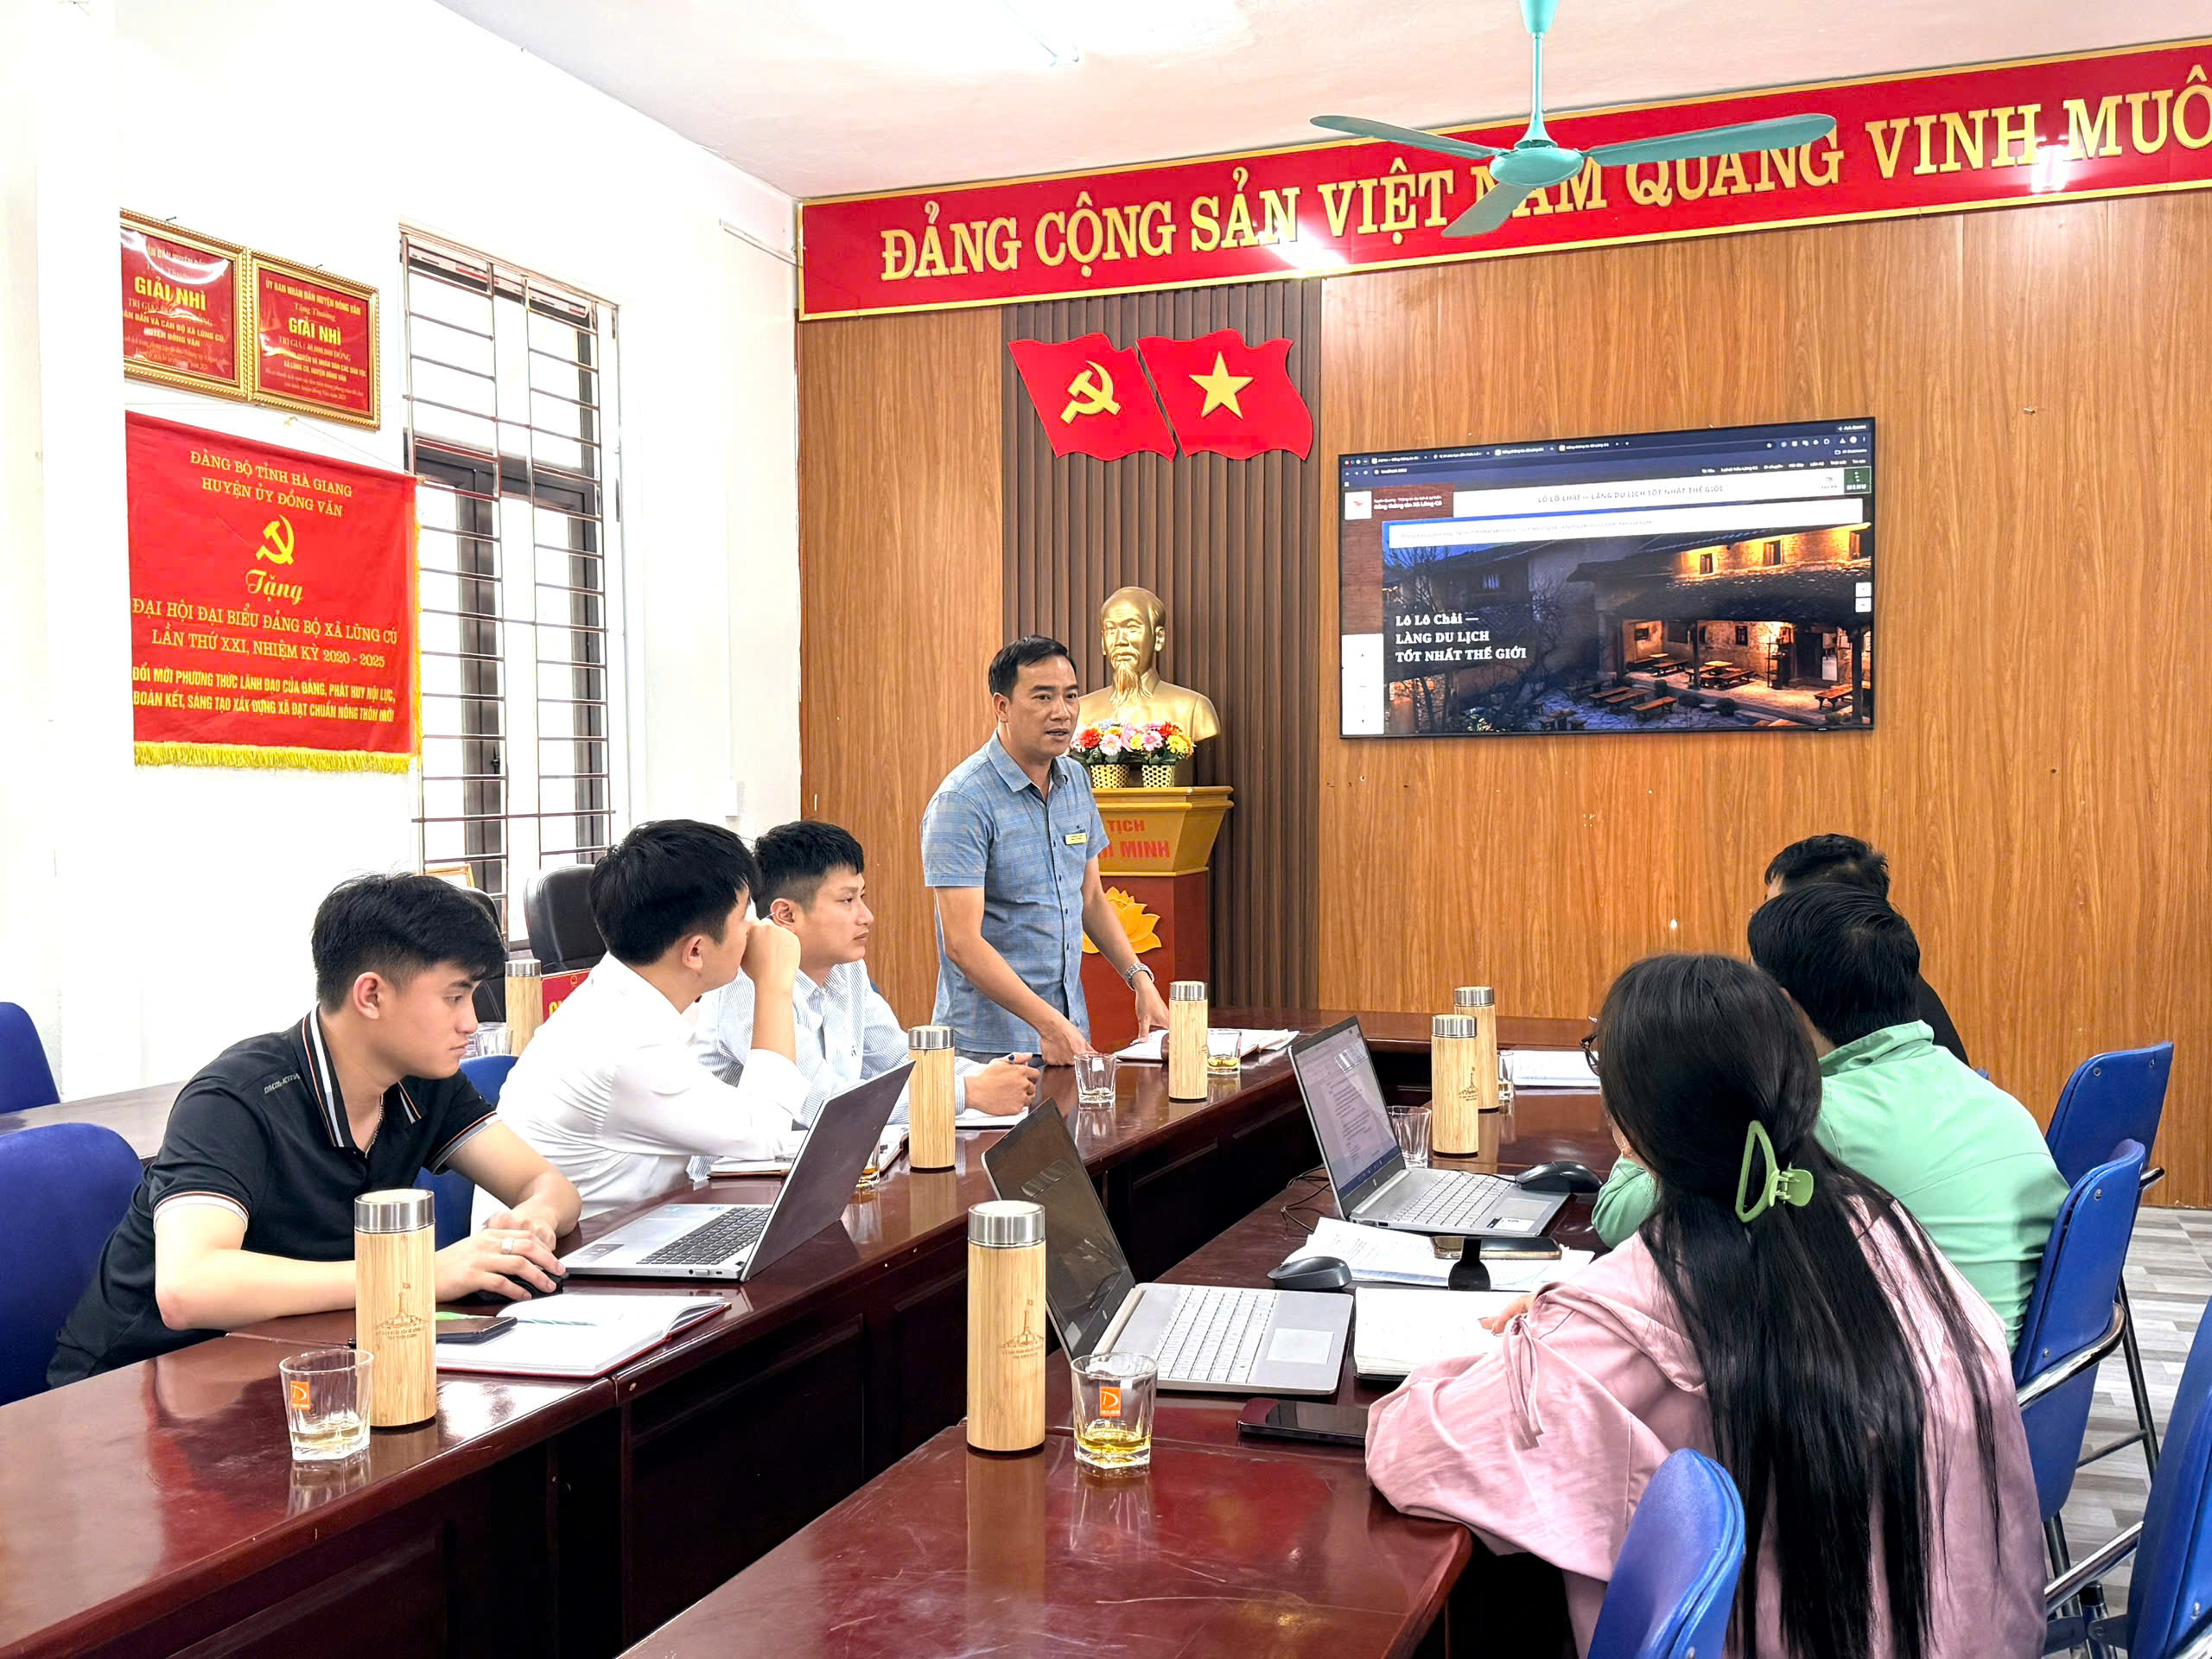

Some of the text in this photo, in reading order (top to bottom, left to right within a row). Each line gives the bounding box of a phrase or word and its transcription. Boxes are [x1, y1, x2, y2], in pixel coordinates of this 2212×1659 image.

[880, 200, 1022, 281] ĐẢNG
[1035, 191, 1177, 277] CỘNG
[1191, 167, 1300, 251] SẢN
[1317, 156, 1453, 245] VIỆT
[1625, 124, 1844, 207] QUANG
[1865, 104, 2041, 180] VINH
[135, 276, 207, 311] GIẢI NHÌ
[289, 316, 341, 346] GIẢI NHÌ
[190, 449, 353, 499] ĐẢNG BỘ TỈNH HÀ GIANG
[201, 477, 344, 518] HUYỆN ỦY ĐỒNG VĂN
[245, 569, 303, 606] Tặng
[132, 598, 162, 619] ĐẠI
[167, 599, 194, 622] HỘI
[197, 606, 224, 626] ĐẠI
[227, 602, 259, 628] BIỂU
[263, 609, 300, 632] ĐẢNG
[303, 616, 321, 639] BỘ
[324, 620, 342, 639] XÃ
[383, 627, 397, 645] CÚ
[1395, 614, 1412, 626] Lô
[1414, 613, 1431, 626] Lô
[1433, 612, 1463, 625] Chải
[151, 622, 184, 647] LẦN
[188, 631, 219, 651] THỨ
[221, 637, 250, 656] XXI,
[252, 639, 298, 661] NHIỆM
[301, 643, 320, 661] KỲ
[323, 650, 350, 664] 2020
[359, 653, 385, 668] 2025
[1395, 631, 1490, 645] LÀNG DU LỊCH
[1395, 645, 1528, 663] TỐT NHẤT THẾ GIỚI
[154, 665, 173, 683] MỚI
[175, 670, 213, 687] PHƯƠNG
[215, 671, 238, 689] THỨC
[264, 677, 281, 694] ĐẠO
[283, 676, 300, 694] CỦA
[329, 682, 349, 698] PHÁT
[351, 685, 365, 699] HUY
[188, 692, 213, 709] SÁNG
[214, 696, 231, 713] TẠO
[278, 699, 289, 715] XÃ
[292, 702, 308, 719] ĐẠT
[1106, 819, 1145, 835] TỊCH
[1120, 840, 1170, 858] MINH
